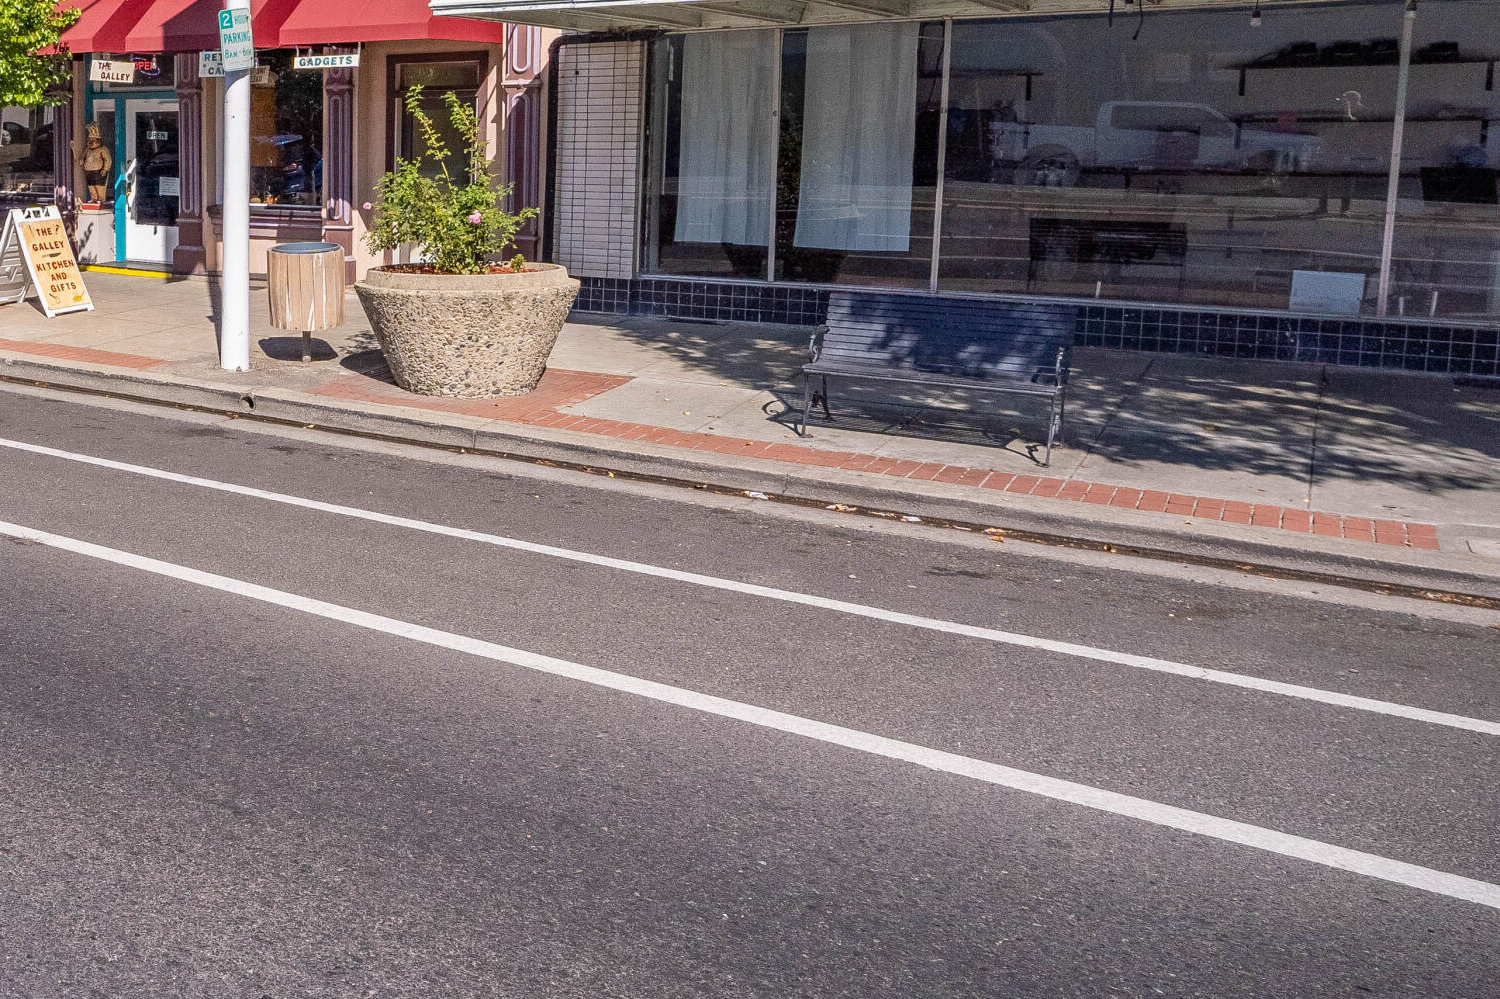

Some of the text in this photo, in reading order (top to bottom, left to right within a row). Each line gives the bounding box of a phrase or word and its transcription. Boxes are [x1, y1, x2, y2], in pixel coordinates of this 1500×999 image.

[222, 13, 231, 27] 2
[223, 31, 251, 44] PARKING
[98, 62, 113, 71] THE
[299, 56, 353, 67] GADGETS
[100, 72, 131, 81] GALLEY
[147, 131, 166, 139] OPEN
[36, 228, 52, 236] THE
[32, 240, 65, 252] GALLEY
[35, 259, 75, 272] KITCHEN
[51, 272, 67, 281] AND
[50, 281, 77, 293] GIFTS
